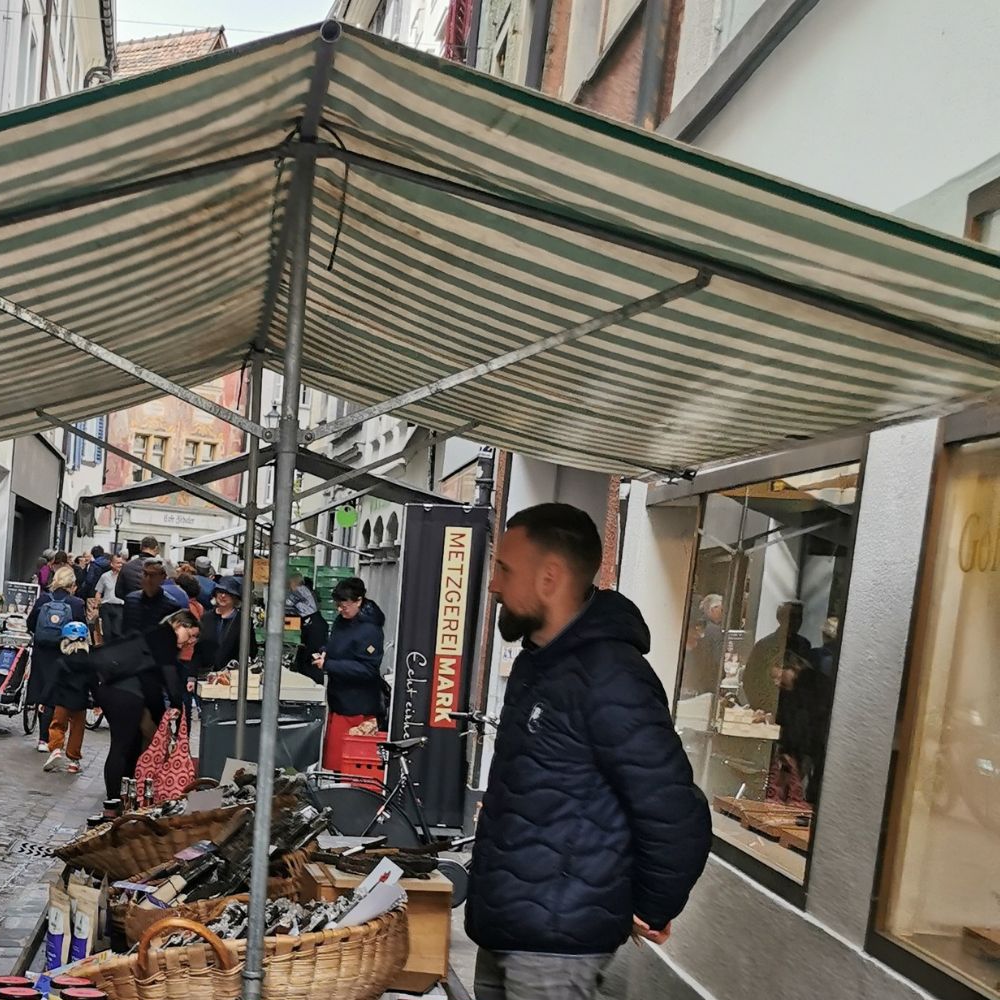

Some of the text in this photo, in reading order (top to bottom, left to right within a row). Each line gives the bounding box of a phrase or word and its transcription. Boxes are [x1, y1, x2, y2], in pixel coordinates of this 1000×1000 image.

[441, 532, 466, 651] METZGEREI
[406, 651, 427, 698] Echt
[434, 657, 457, 723] MARK
